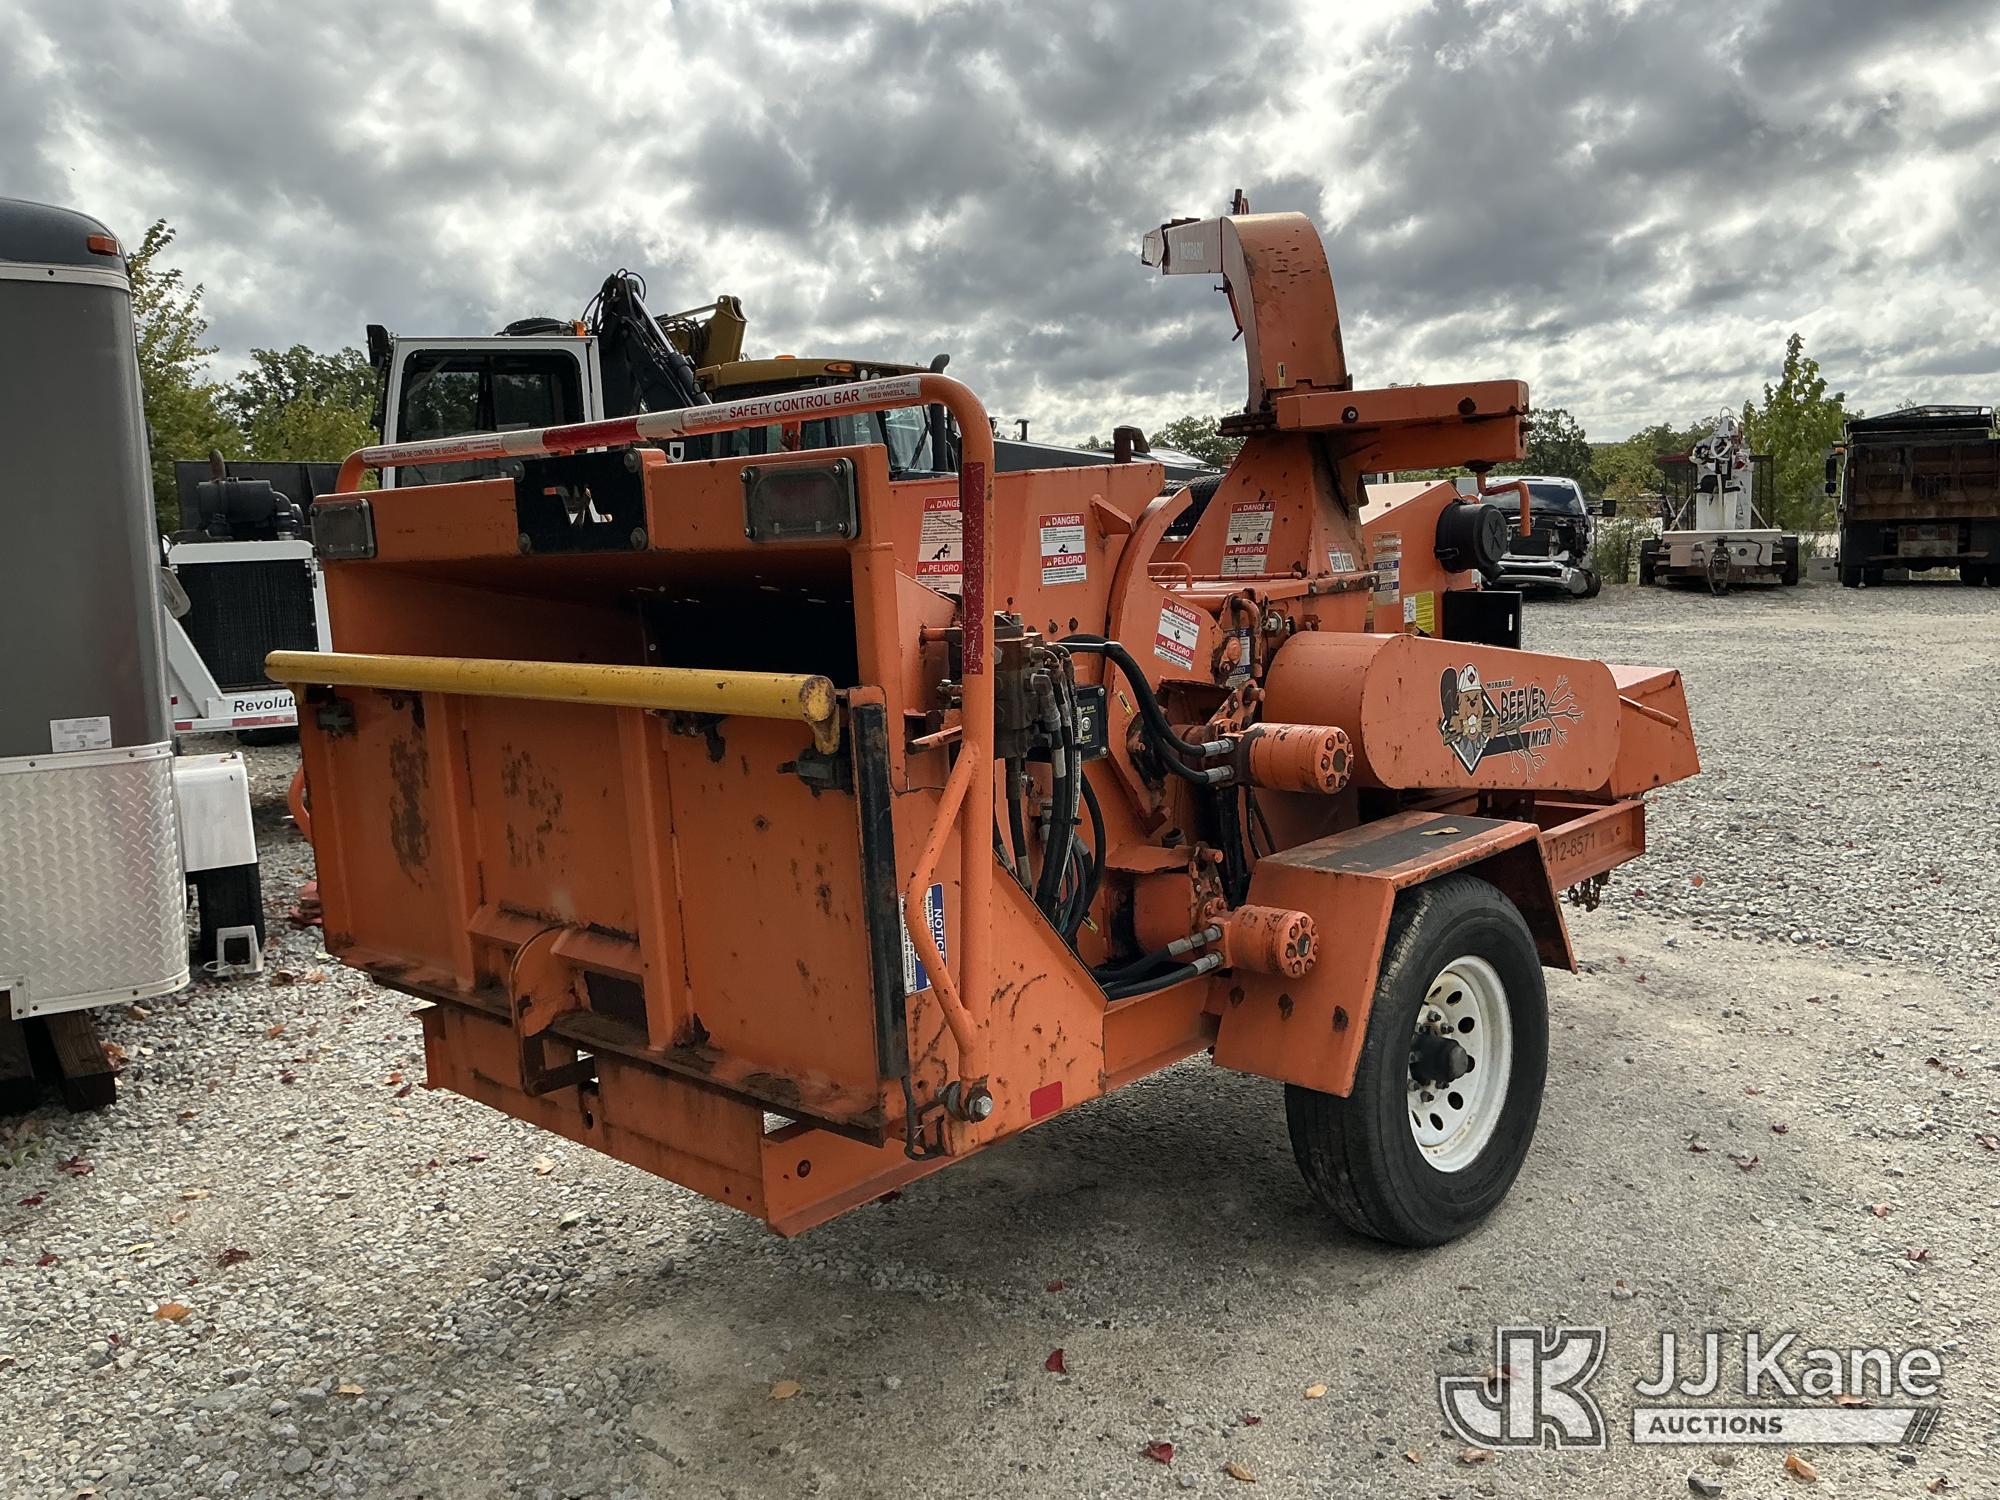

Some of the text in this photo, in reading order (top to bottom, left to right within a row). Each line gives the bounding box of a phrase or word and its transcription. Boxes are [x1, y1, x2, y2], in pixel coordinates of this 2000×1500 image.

[729, 389, 860, 418] SAFETY CONTROL BAR
[1052, 515, 1081, 526] DANGER
[1234, 546, 1265, 554] PELIGRO
[928, 563, 960, 573] PELIGRO
[1053, 555, 1083, 566] PELIGRO
[1174, 605, 1196, 622] DANGER
[1167, 640, 1190, 657] PELIGRO
[1501, 683, 1547, 725] BEEVER
[1531, 727, 1552, 747] M12R
